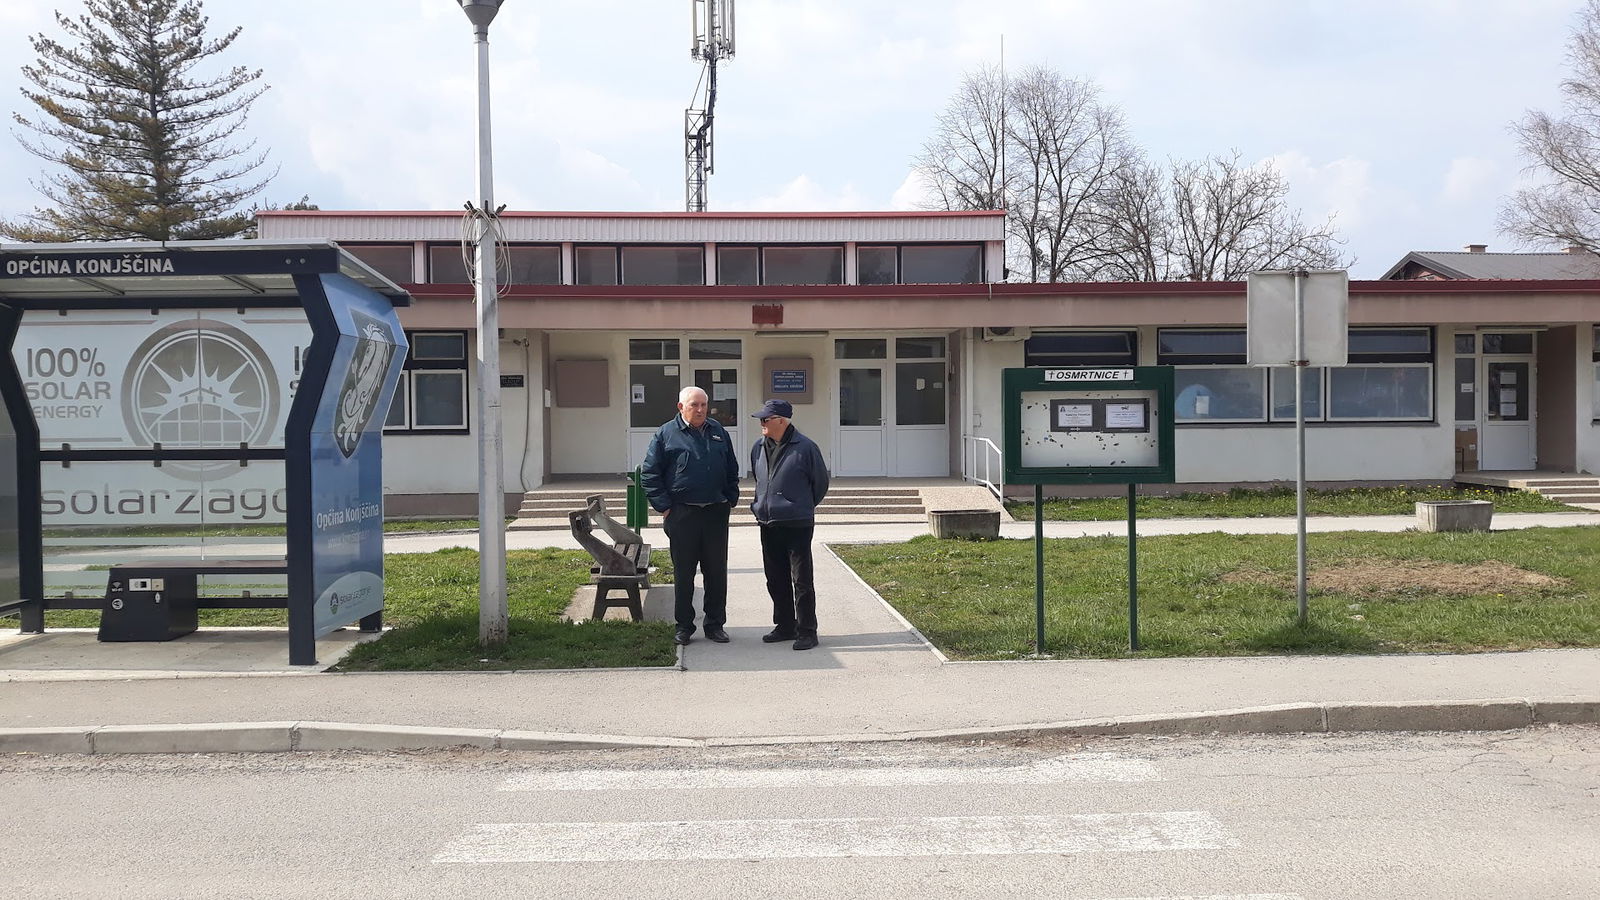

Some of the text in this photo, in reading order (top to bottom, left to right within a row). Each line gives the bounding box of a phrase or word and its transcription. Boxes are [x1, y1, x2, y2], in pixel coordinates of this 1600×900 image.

[6, 254, 175, 275] OPĆINA KONJŠČINA
[27, 347, 106, 378] 100%
[1056, 371, 1120, 380] OSMRTNICE
[23, 381, 112, 401] SOLAR
[33, 405, 104, 419] ENERGY
[316, 502, 379, 532] Općina Konjščina
